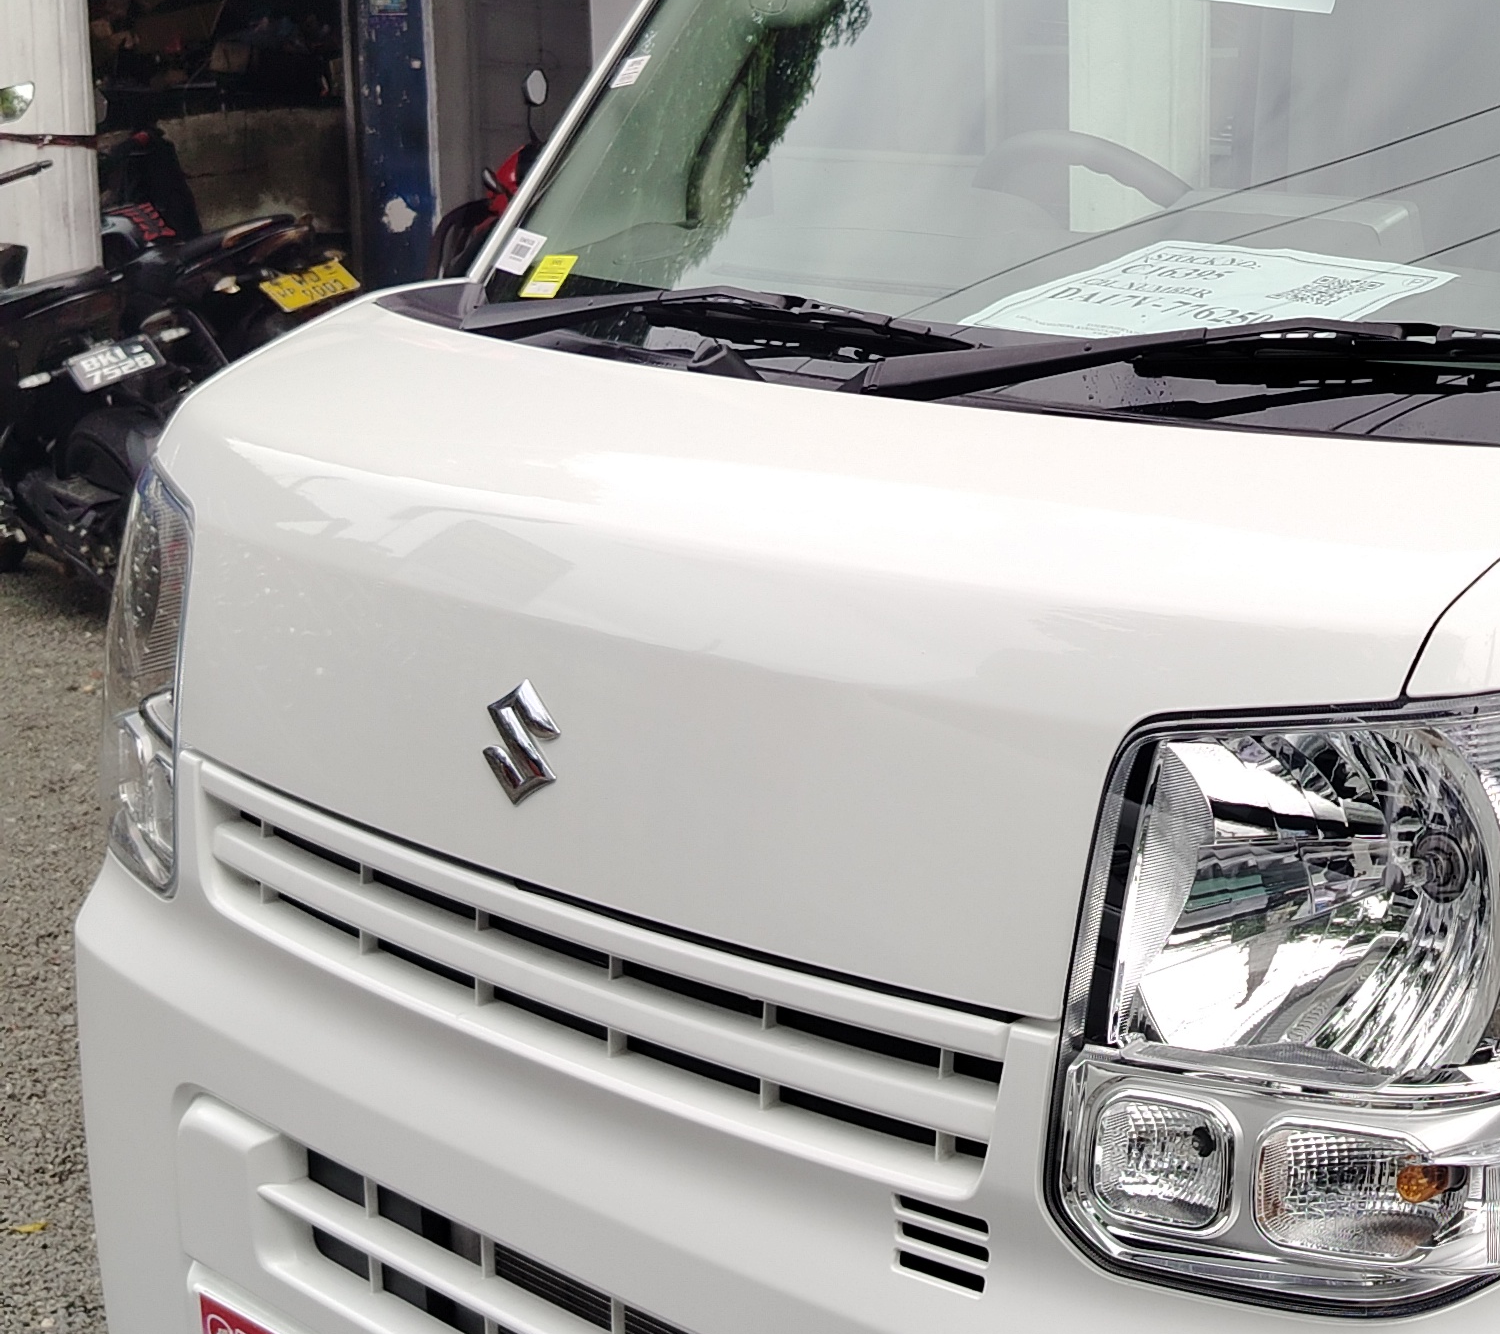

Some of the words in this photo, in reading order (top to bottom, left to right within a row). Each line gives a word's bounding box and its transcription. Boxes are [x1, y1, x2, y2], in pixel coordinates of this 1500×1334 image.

[1150, 252, 1217, 266] STOCK
[1121, 263, 1236, 281] C16395
[85, 352, 156, 386] 7528
